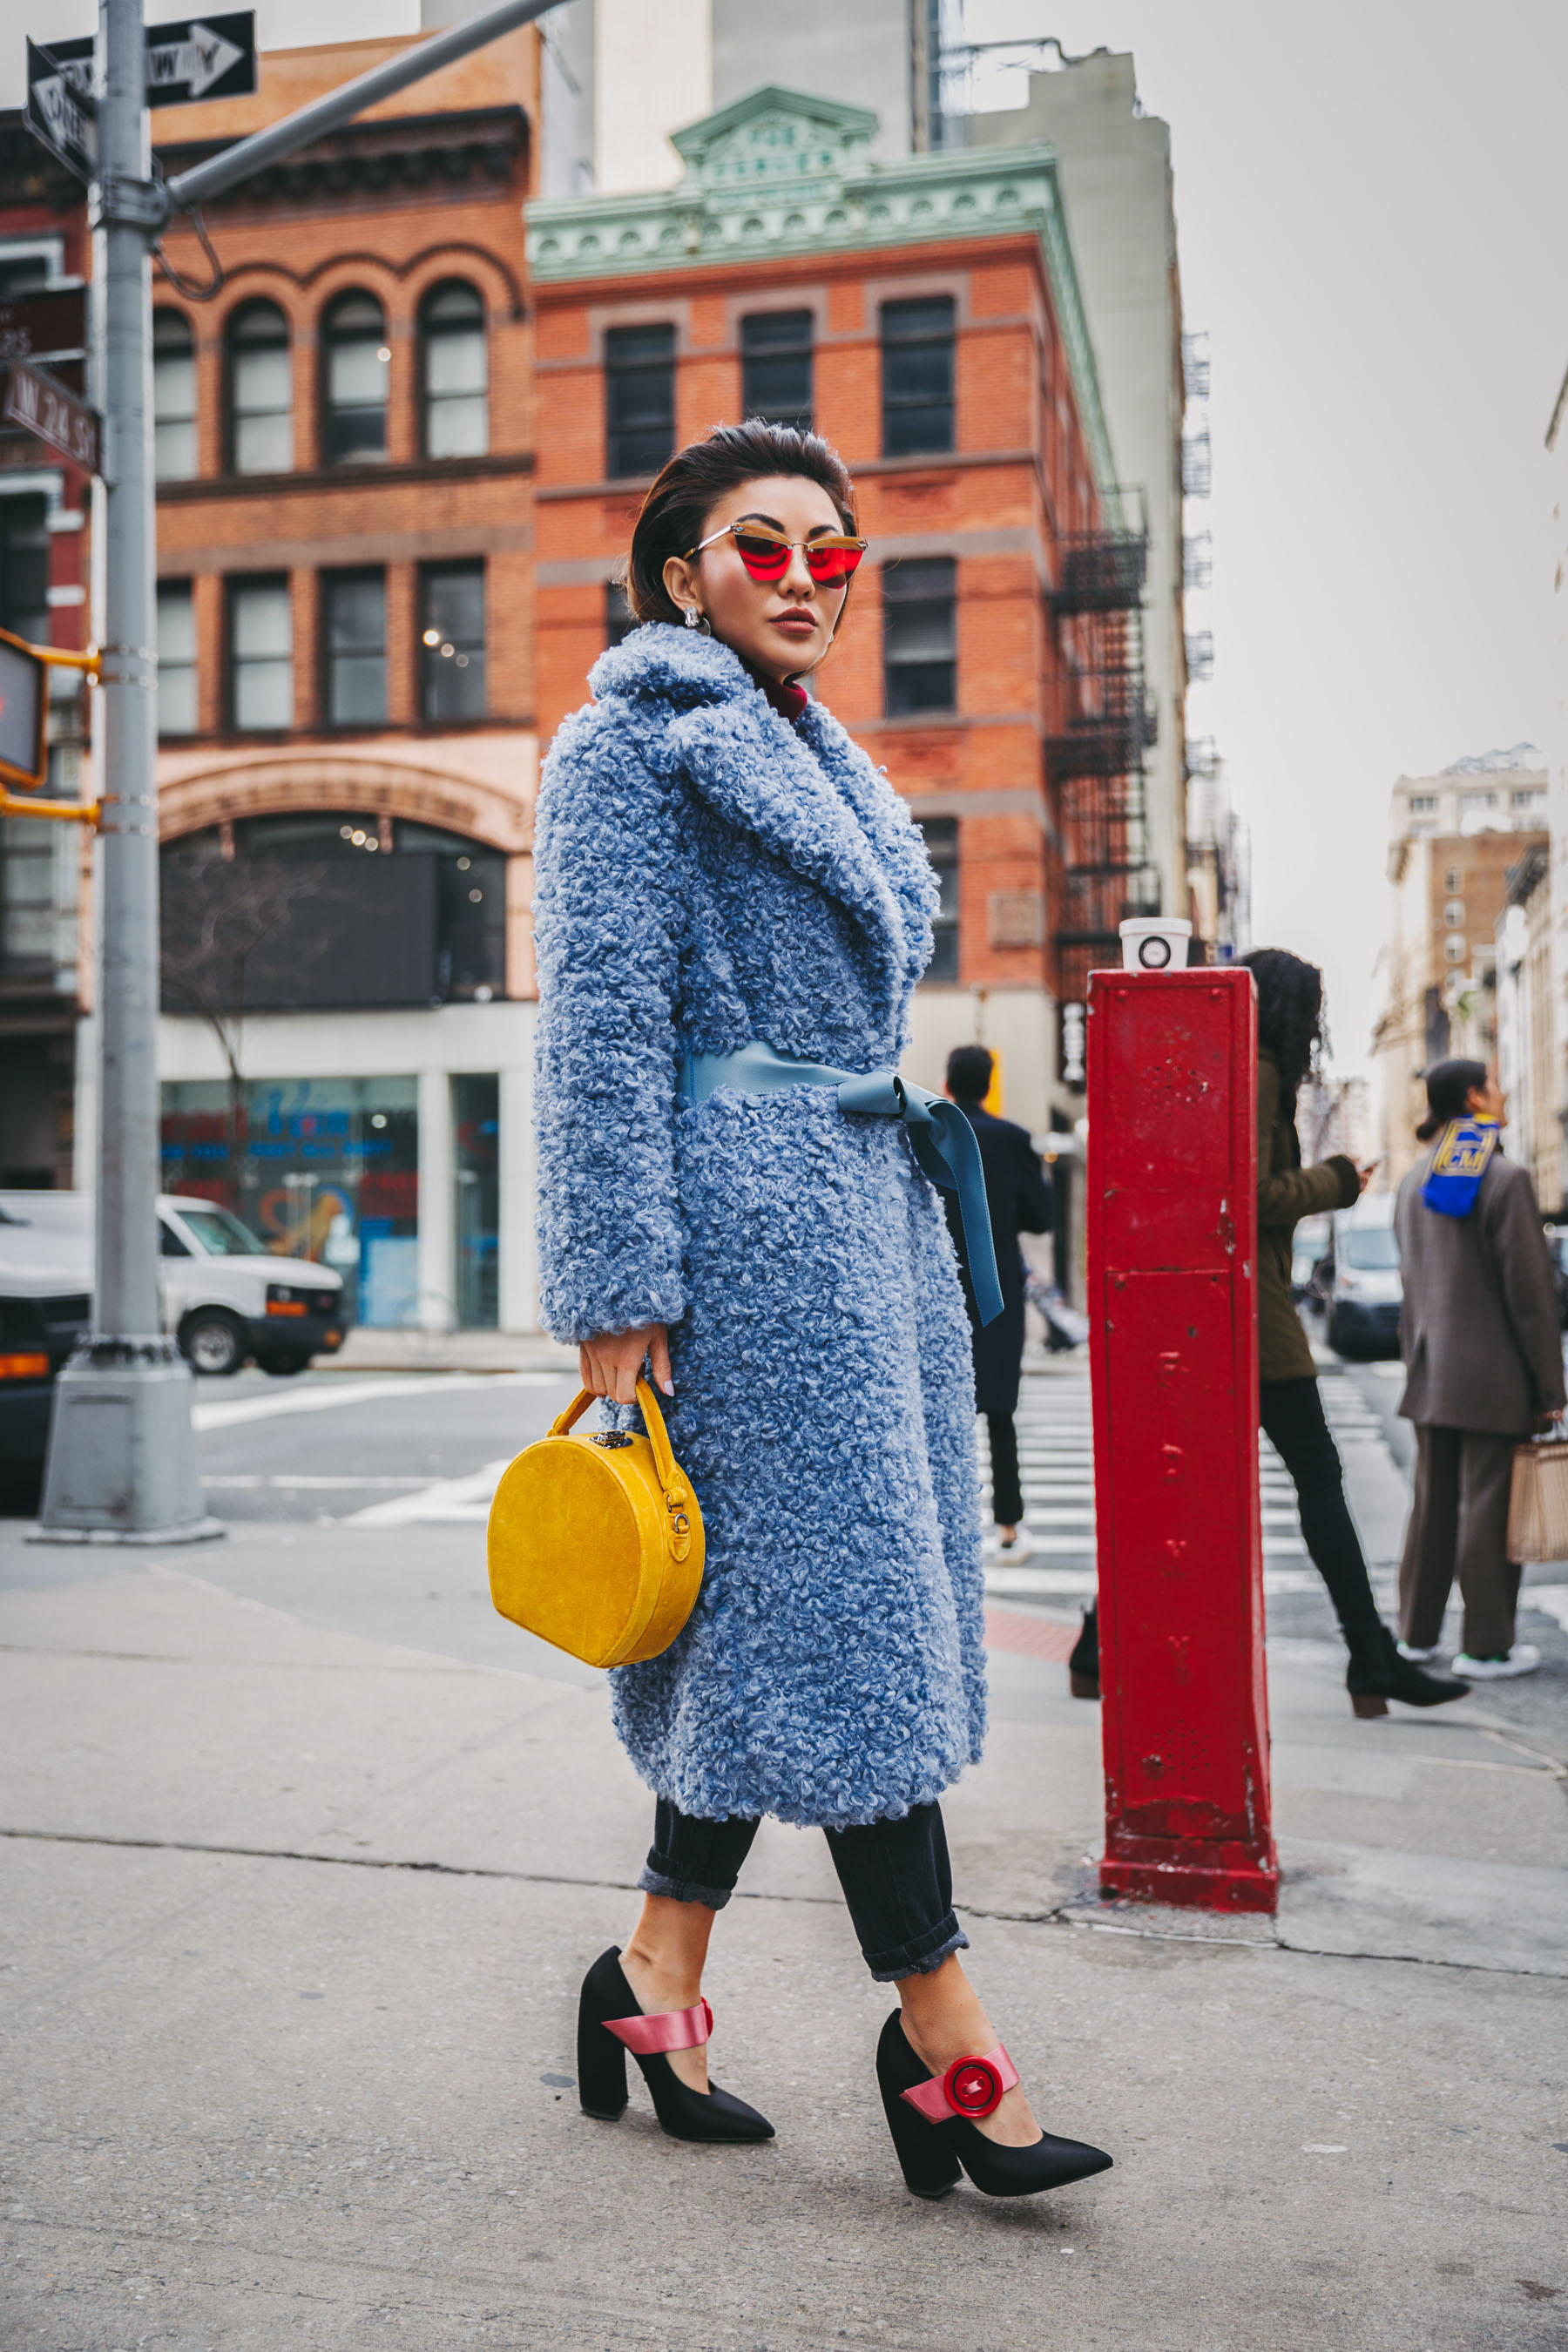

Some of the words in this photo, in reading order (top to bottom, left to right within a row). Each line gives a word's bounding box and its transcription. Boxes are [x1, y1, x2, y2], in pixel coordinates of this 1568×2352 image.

[150, 42, 221, 79] WY
[17, 373, 39, 422] W
[44, 391, 69, 444] 24
